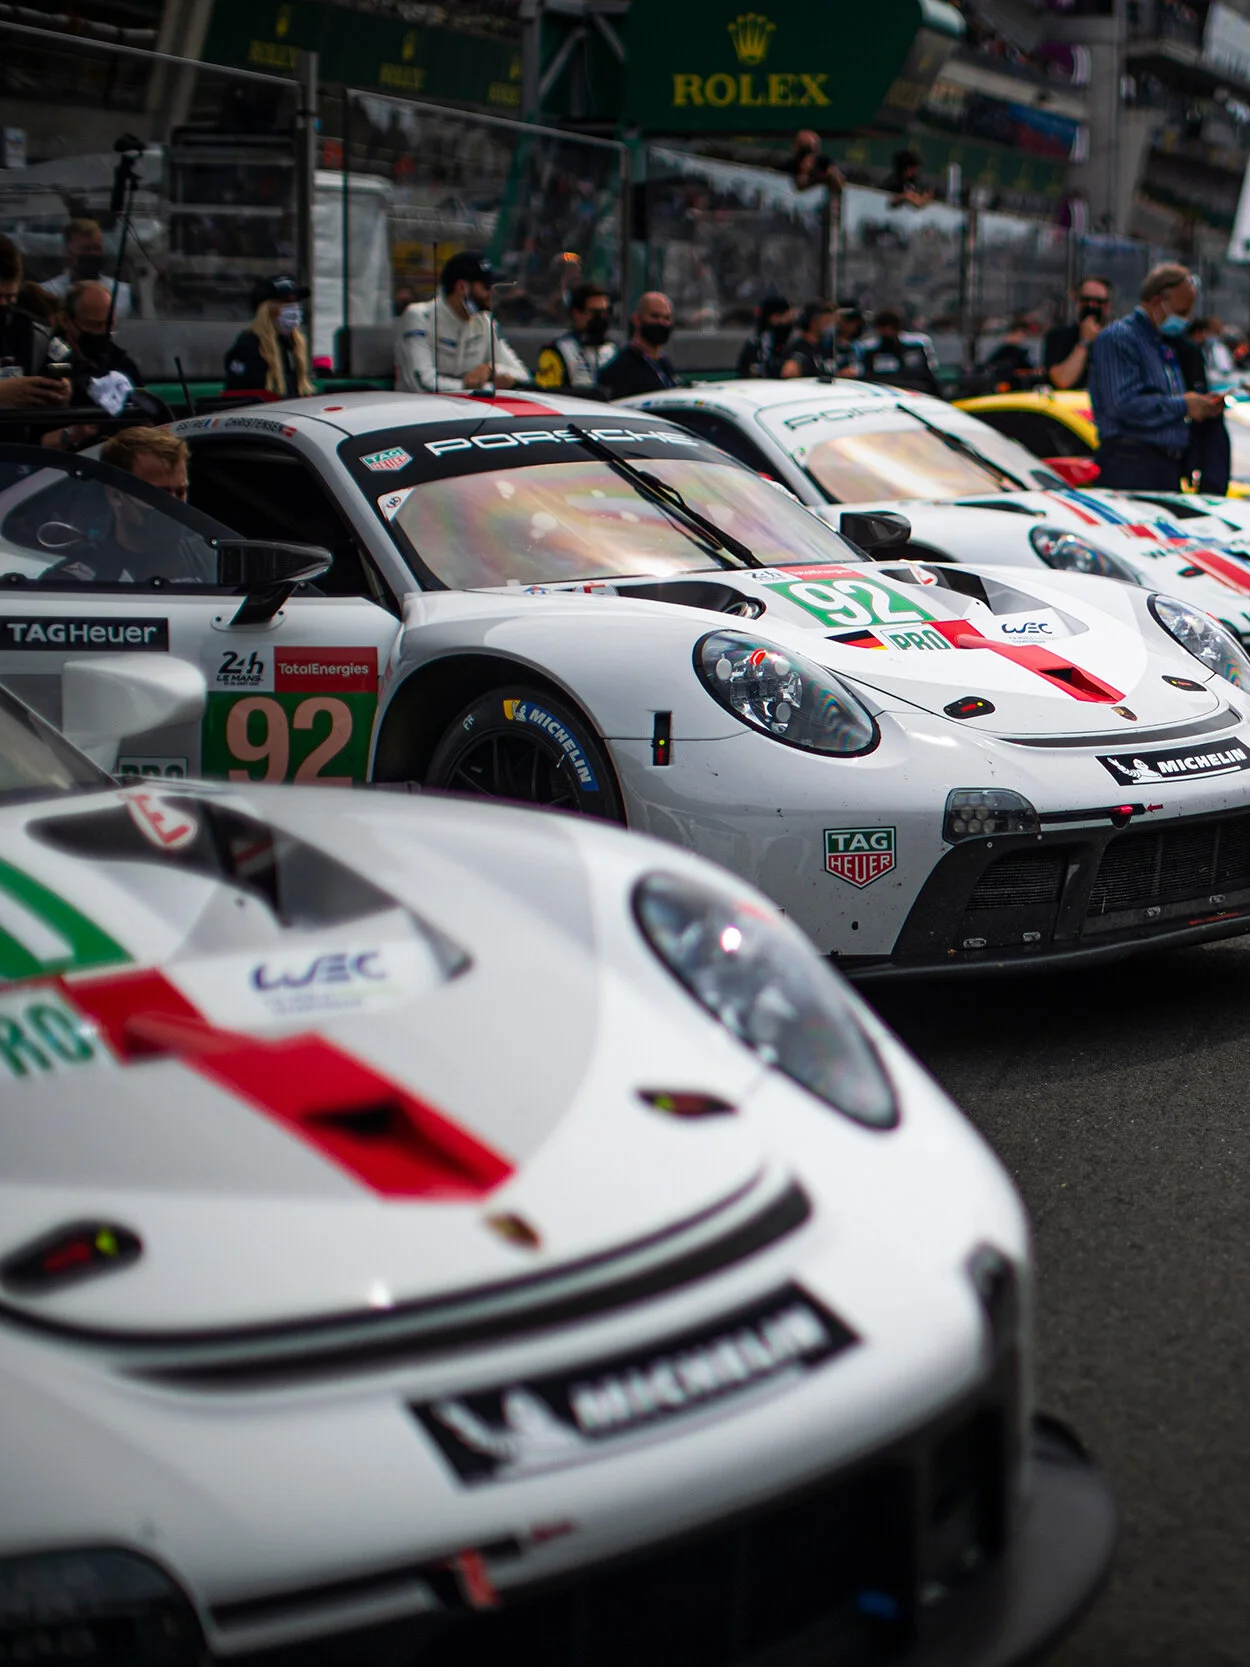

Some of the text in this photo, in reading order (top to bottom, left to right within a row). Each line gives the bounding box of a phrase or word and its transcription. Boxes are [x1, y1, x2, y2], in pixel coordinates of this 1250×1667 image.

[673, 73, 831, 107] ROLEX
[424, 429, 699, 457] PORSCHE
[365, 449, 404, 464] TAG
[789, 579, 926, 625] 92
[7, 622, 157, 644] TAGHeuer
[888, 630, 950, 650] PRO
[1001, 622, 1053, 635] WEC
[218, 651, 264, 674] 24h
[278, 662, 369, 678] TotalEnergies
[226, 696, 353, 788] 92
[529, 708, 592, 783] MICHELIN
[1157, 748, 1247, 774] MICHELIN
[831, 832, 888, 851] TAG
[831, 855, 890, 882] HEUER
[253, 952, 387, 991] WEC
